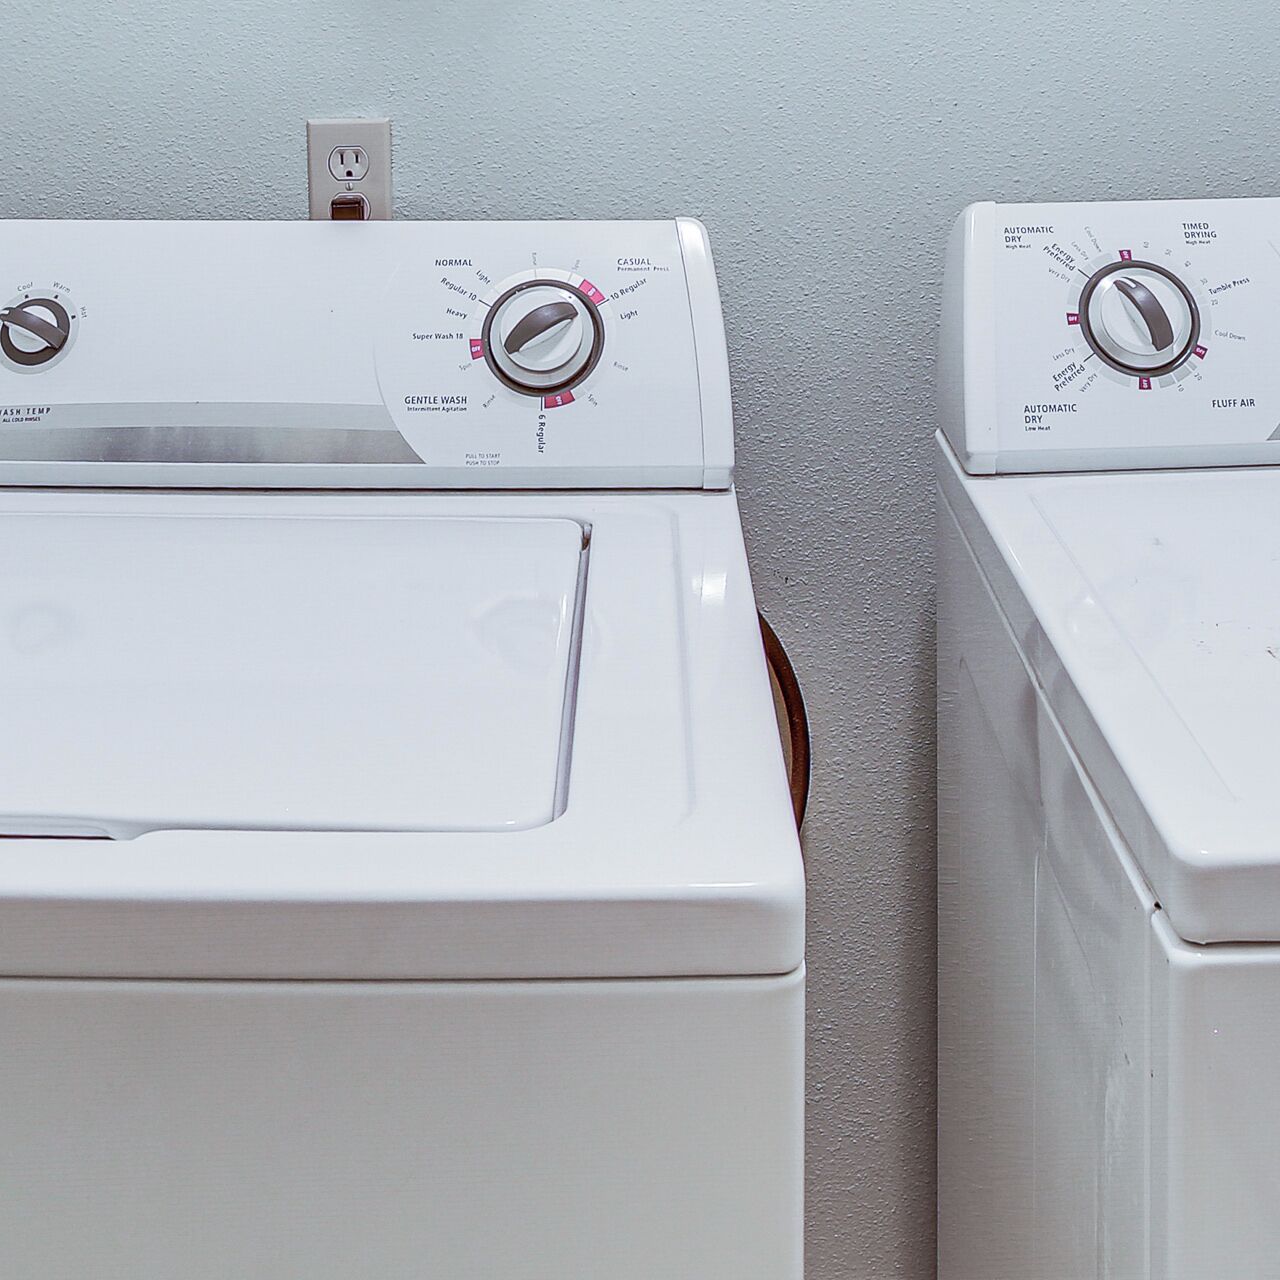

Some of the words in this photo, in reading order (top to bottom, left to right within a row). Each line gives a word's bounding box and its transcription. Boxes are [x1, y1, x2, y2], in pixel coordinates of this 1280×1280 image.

[1004, 226, 1055, 235] AUTOMATIC
[1182, 222, 1210, 230] TIMED
[1005, 235, 1022, 243] DRY
[1184, 231, 1218, 239] DRYING
[1042, 245, 1076, 272] Preferred
[1051, 243, 1076, 264] Energy
[434, 259, 473, 267] NORMAL
[617, 258, 652, 266] CASUAL
[476, 269, 491, 285] Light
[17, 282, 33, 292] Cool
[440, 277, 468, 297] Regular
[620, 278, 648, 297] Regular
[1208, 283, 1232, 296] Tumble
[1232, 277, 1250, 288] Press
[446, 307, 468, 320] Heavy
[620, 309, 639, 320] Light
[412, 332, 433, 341] Super
[434, 332, 454, 340] Wash
[1214, 329, 1228, 338] Cool
[1052, 361, 1077, 382] Energy
[1054, 364, 1086, 392] Preferred
[404, 395, 439, 405] GENTLE
[440, 395, 468, 405] WASH
[1212, 399, 1237, 408] FLUFF
[1239, 398, 1256, 407] AIR
[26, 407, 52, 415] TEMP
[1023, 403, 1077, 413] AUTOMATIC
[1024, 415, 1043, 424] DRY
[536, 421, 546, 454] Regular
